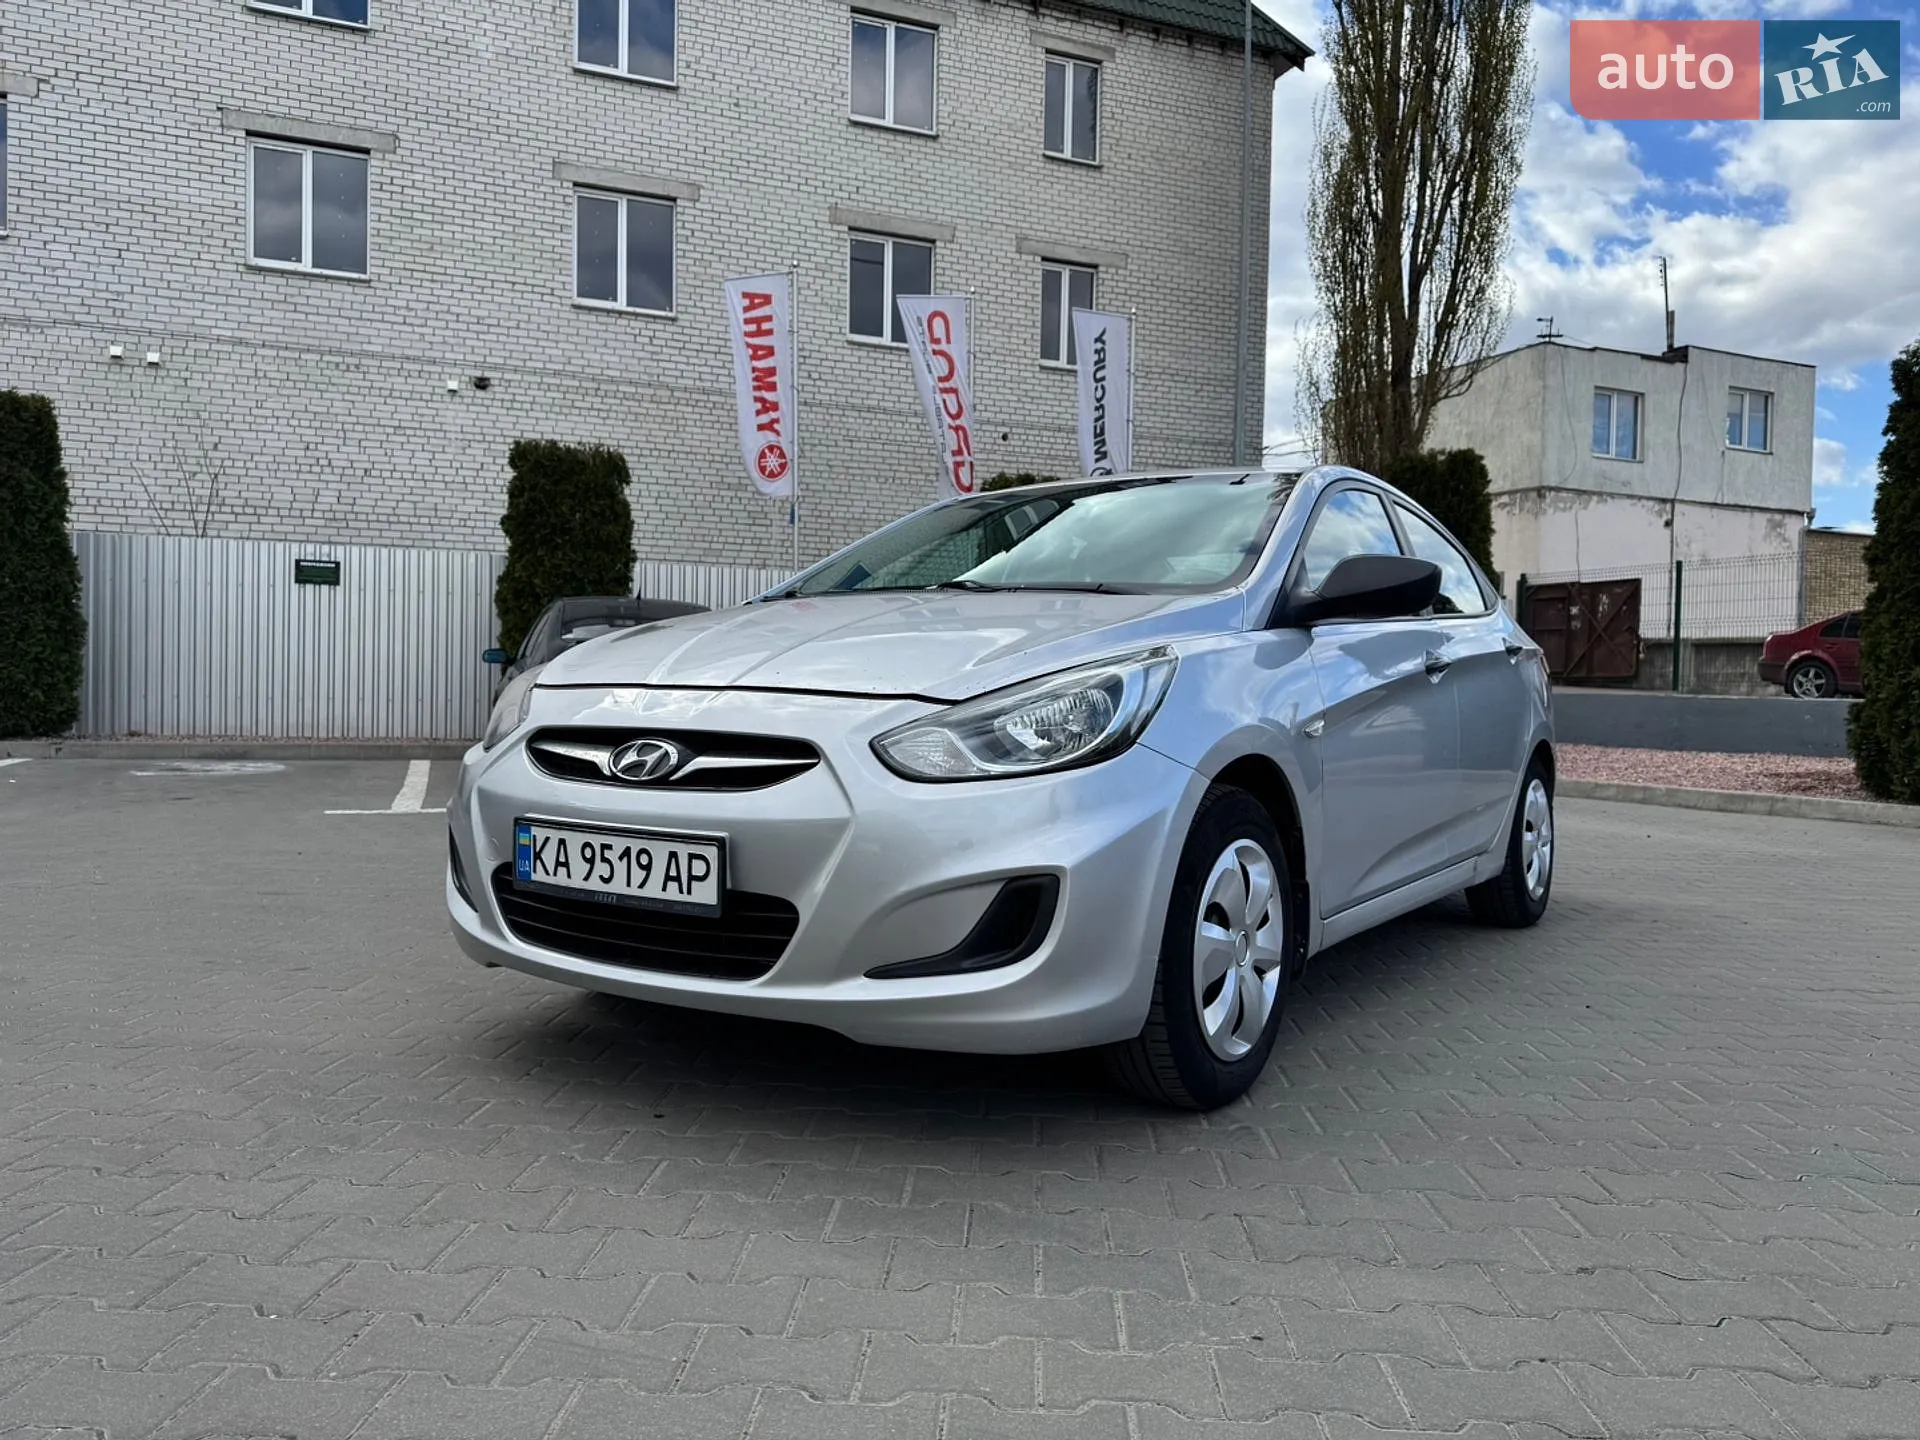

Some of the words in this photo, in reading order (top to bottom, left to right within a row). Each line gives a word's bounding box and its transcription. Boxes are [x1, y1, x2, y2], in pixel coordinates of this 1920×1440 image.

[518, 858, 530, 872] UA
[532, 833, 572, 879] KA
[579, 841, 654, 890] 9519
[661, 850, 711, 896] AP
